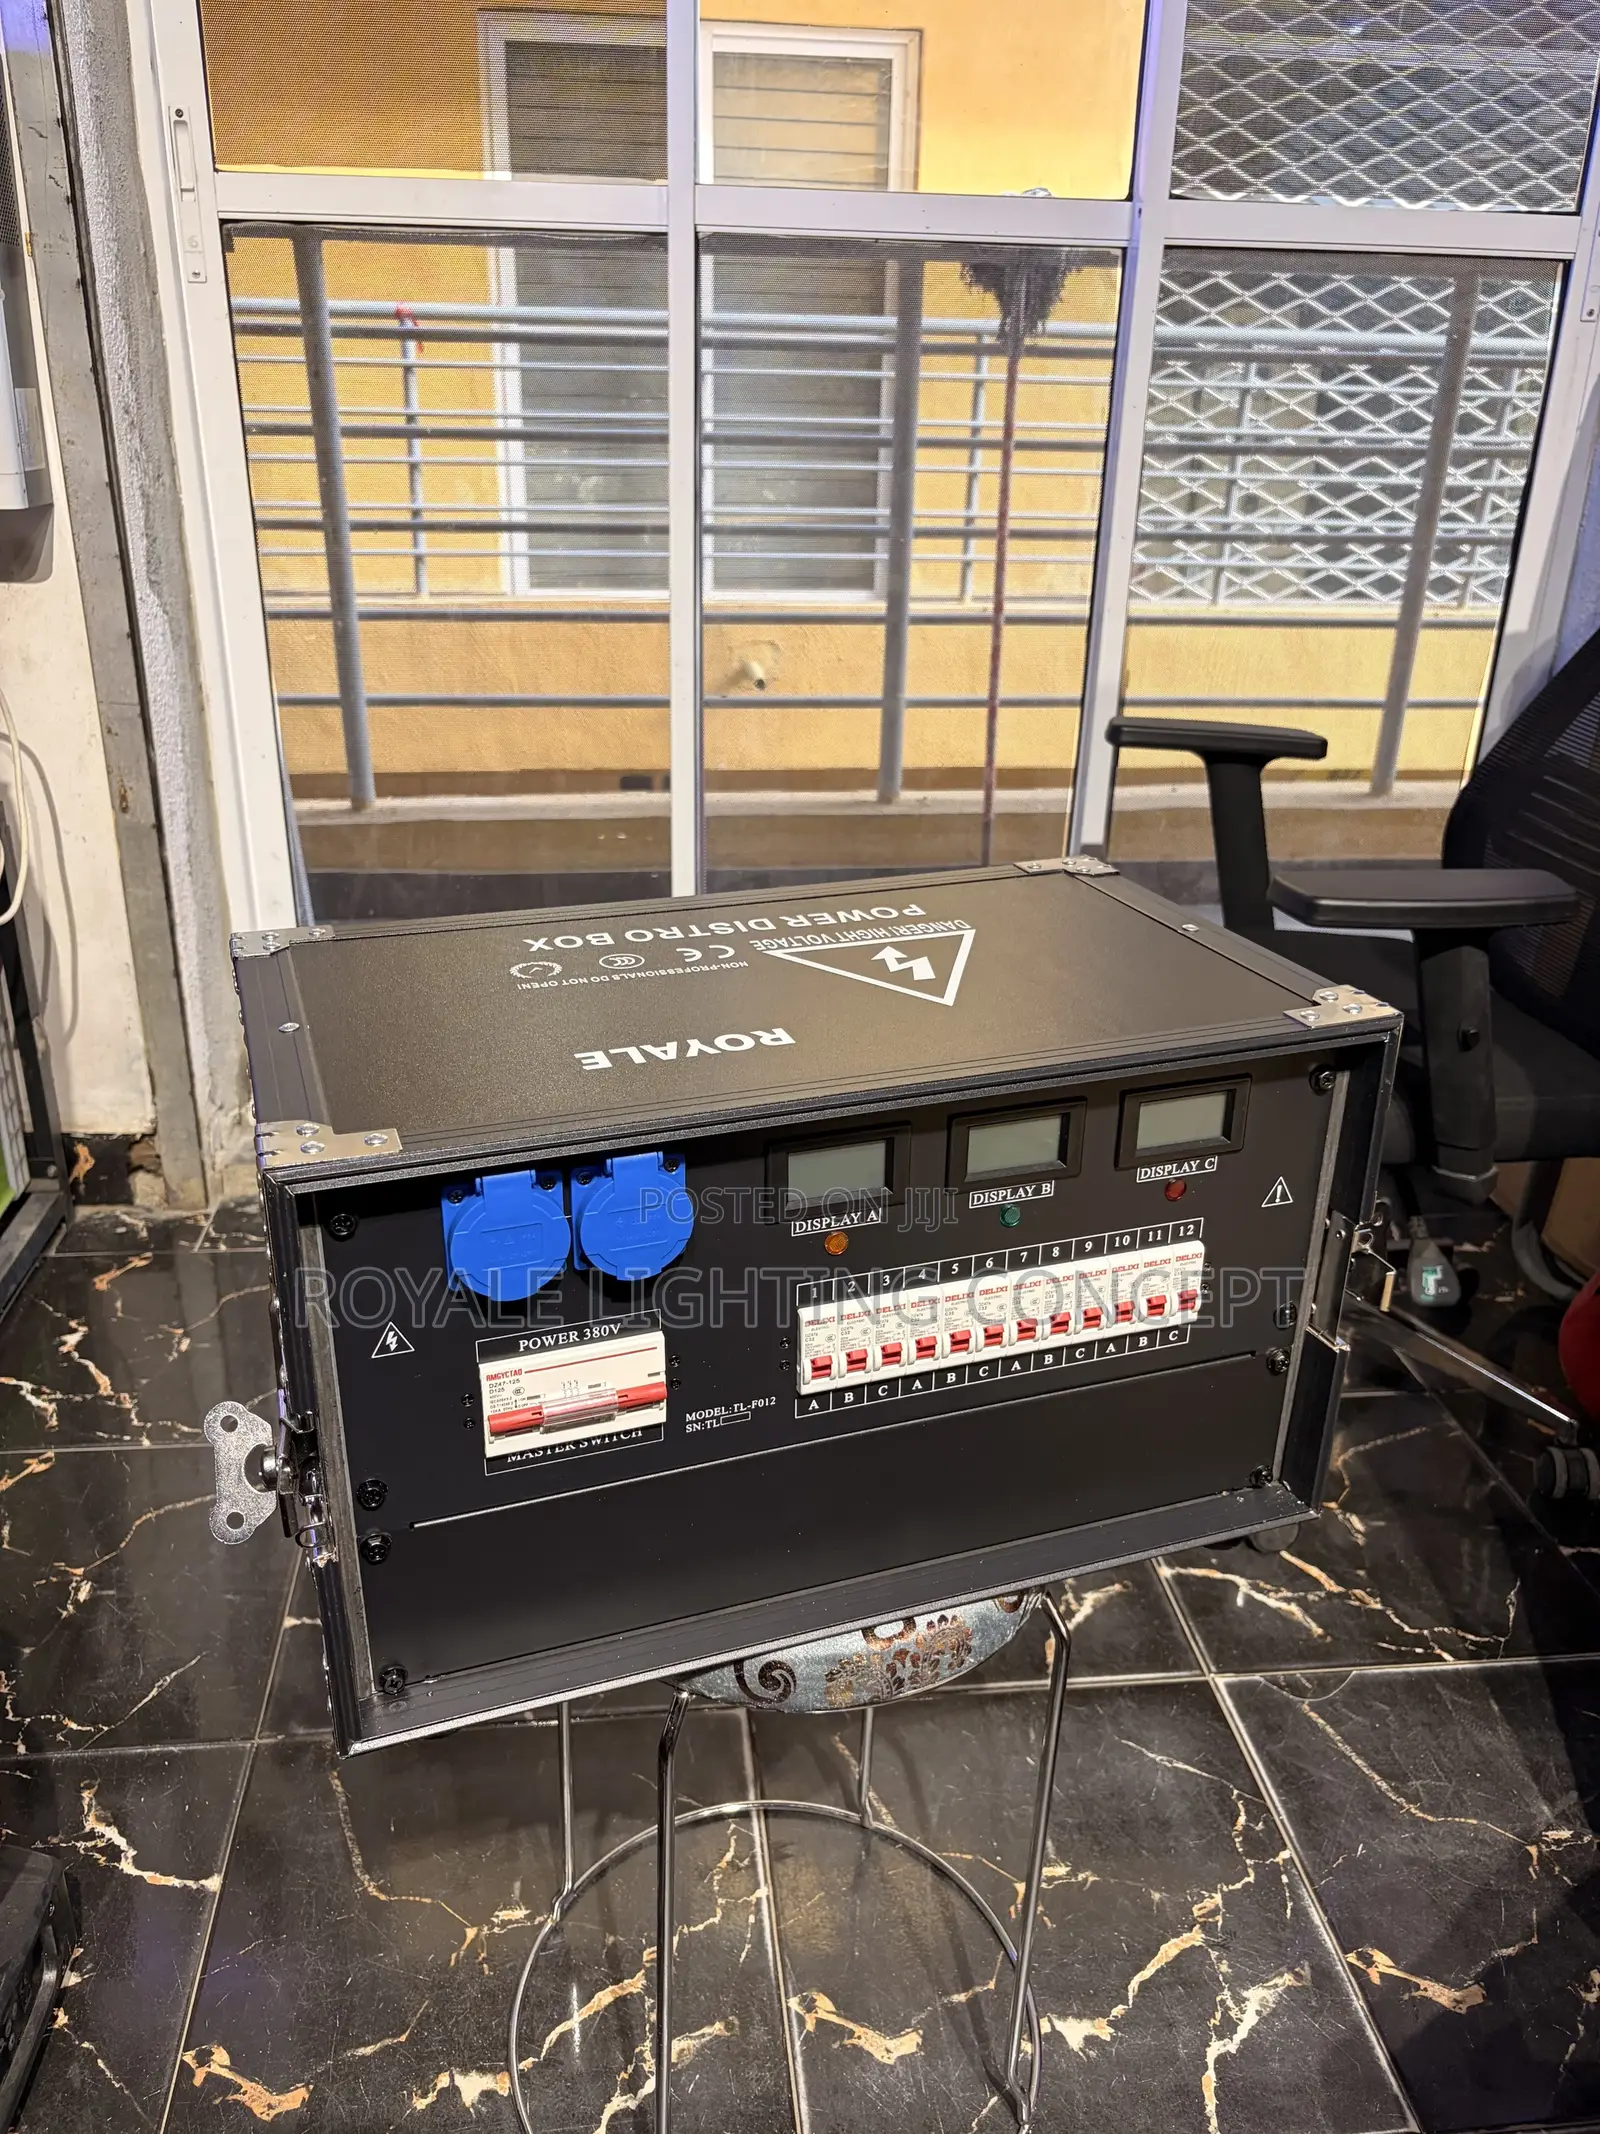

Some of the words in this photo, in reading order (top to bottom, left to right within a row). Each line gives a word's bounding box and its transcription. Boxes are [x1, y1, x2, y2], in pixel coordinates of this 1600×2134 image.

[779, 904, 928, 927] POWER
[624, 918, 777, 942] DISTRO
[835, 927, 892, 943] HIGHT
[889, 919, 971, 936] DANGER!
[523, 932, 615, 952] BOX
[749, 932, 837, 951] VOLTAGE
[611, 960, 749, 980] NON-PROFESSIONALS
[561, 976, 589, 986] NOT
[591, 974, 611, 983] DO
[573, 1027, 796, 1070] ROYALE
[1139, 1160, 1200, 1180] DISPLAY
[1204, 1157, 1215, 1170] C
[972, 1185, 1037, 1206] DISPLAY
[1040, 1183, 1051, 1195] B
[795, 1212, 861, 1234] DISPLAY
[866, 1210, 879, 1222] A
[811, 1287, 818, 1299] 1
[848, 1281, 857, 1292] 2
[882, 1274, 891, 1286] 3
[917, 1268, 928, 1280] 4
[951, 1263, 959, 1275] 5
[985, 1257, 994, 1269] 6
[1019, 1251, 1028, 1263] 7
[1051, 1246, 1060, 1258] 8
[1084, 1241, 1093, 1253] 9
[1114, 1234, 1131, 1248] 10
[1147, 1229, 1162, 1242] 11
[1178, 1224, 1195, 1237] 12
[1143, 1257, 1172, 1268] DELIXI
[1175, 1252, 1203, 1262] DELIXI
[1078, 1269, 1107, 1279] DELIXI
[1111, 1263, 1139, 1273] DELIXI
[1012, 1280, 1042, 1291] DELIXI
[1046, 1275, 1074, 1285] DELIXI
[945, 1292, 975, 1302] DELIXI
[979, 1285, 1008, 1296] DELIXI
[841, 1310, 871, 1321] DELIXI
[518, 1331, 580, 1352] POWER
[583, 1322, 622, 1340] 380V
[809, 1399, 820, 1411] A
[843, 1392, 854, 1404] B
[877, 1385, 889, 1397] C
[911, 1379, 923, 1391] A
[946, 1372, 957, 1384] B
[978, 1366, 989, 1377] C
[1010, 1360, 1022, 1372] A
[1043, 1354, 1054, 1365] B
[1075, 1348, 1086, 1359] C
[1105, 1342, 1117, 1354] A
[1138, 1337, 1148, 1348] B
[1168, 1330, 1179, 1342] C
[488, 1378, 521, 1389] DZ47-125
[489, 1387, 505, 1395] D125
[685, 1418, 720, 1434] SN:TL
